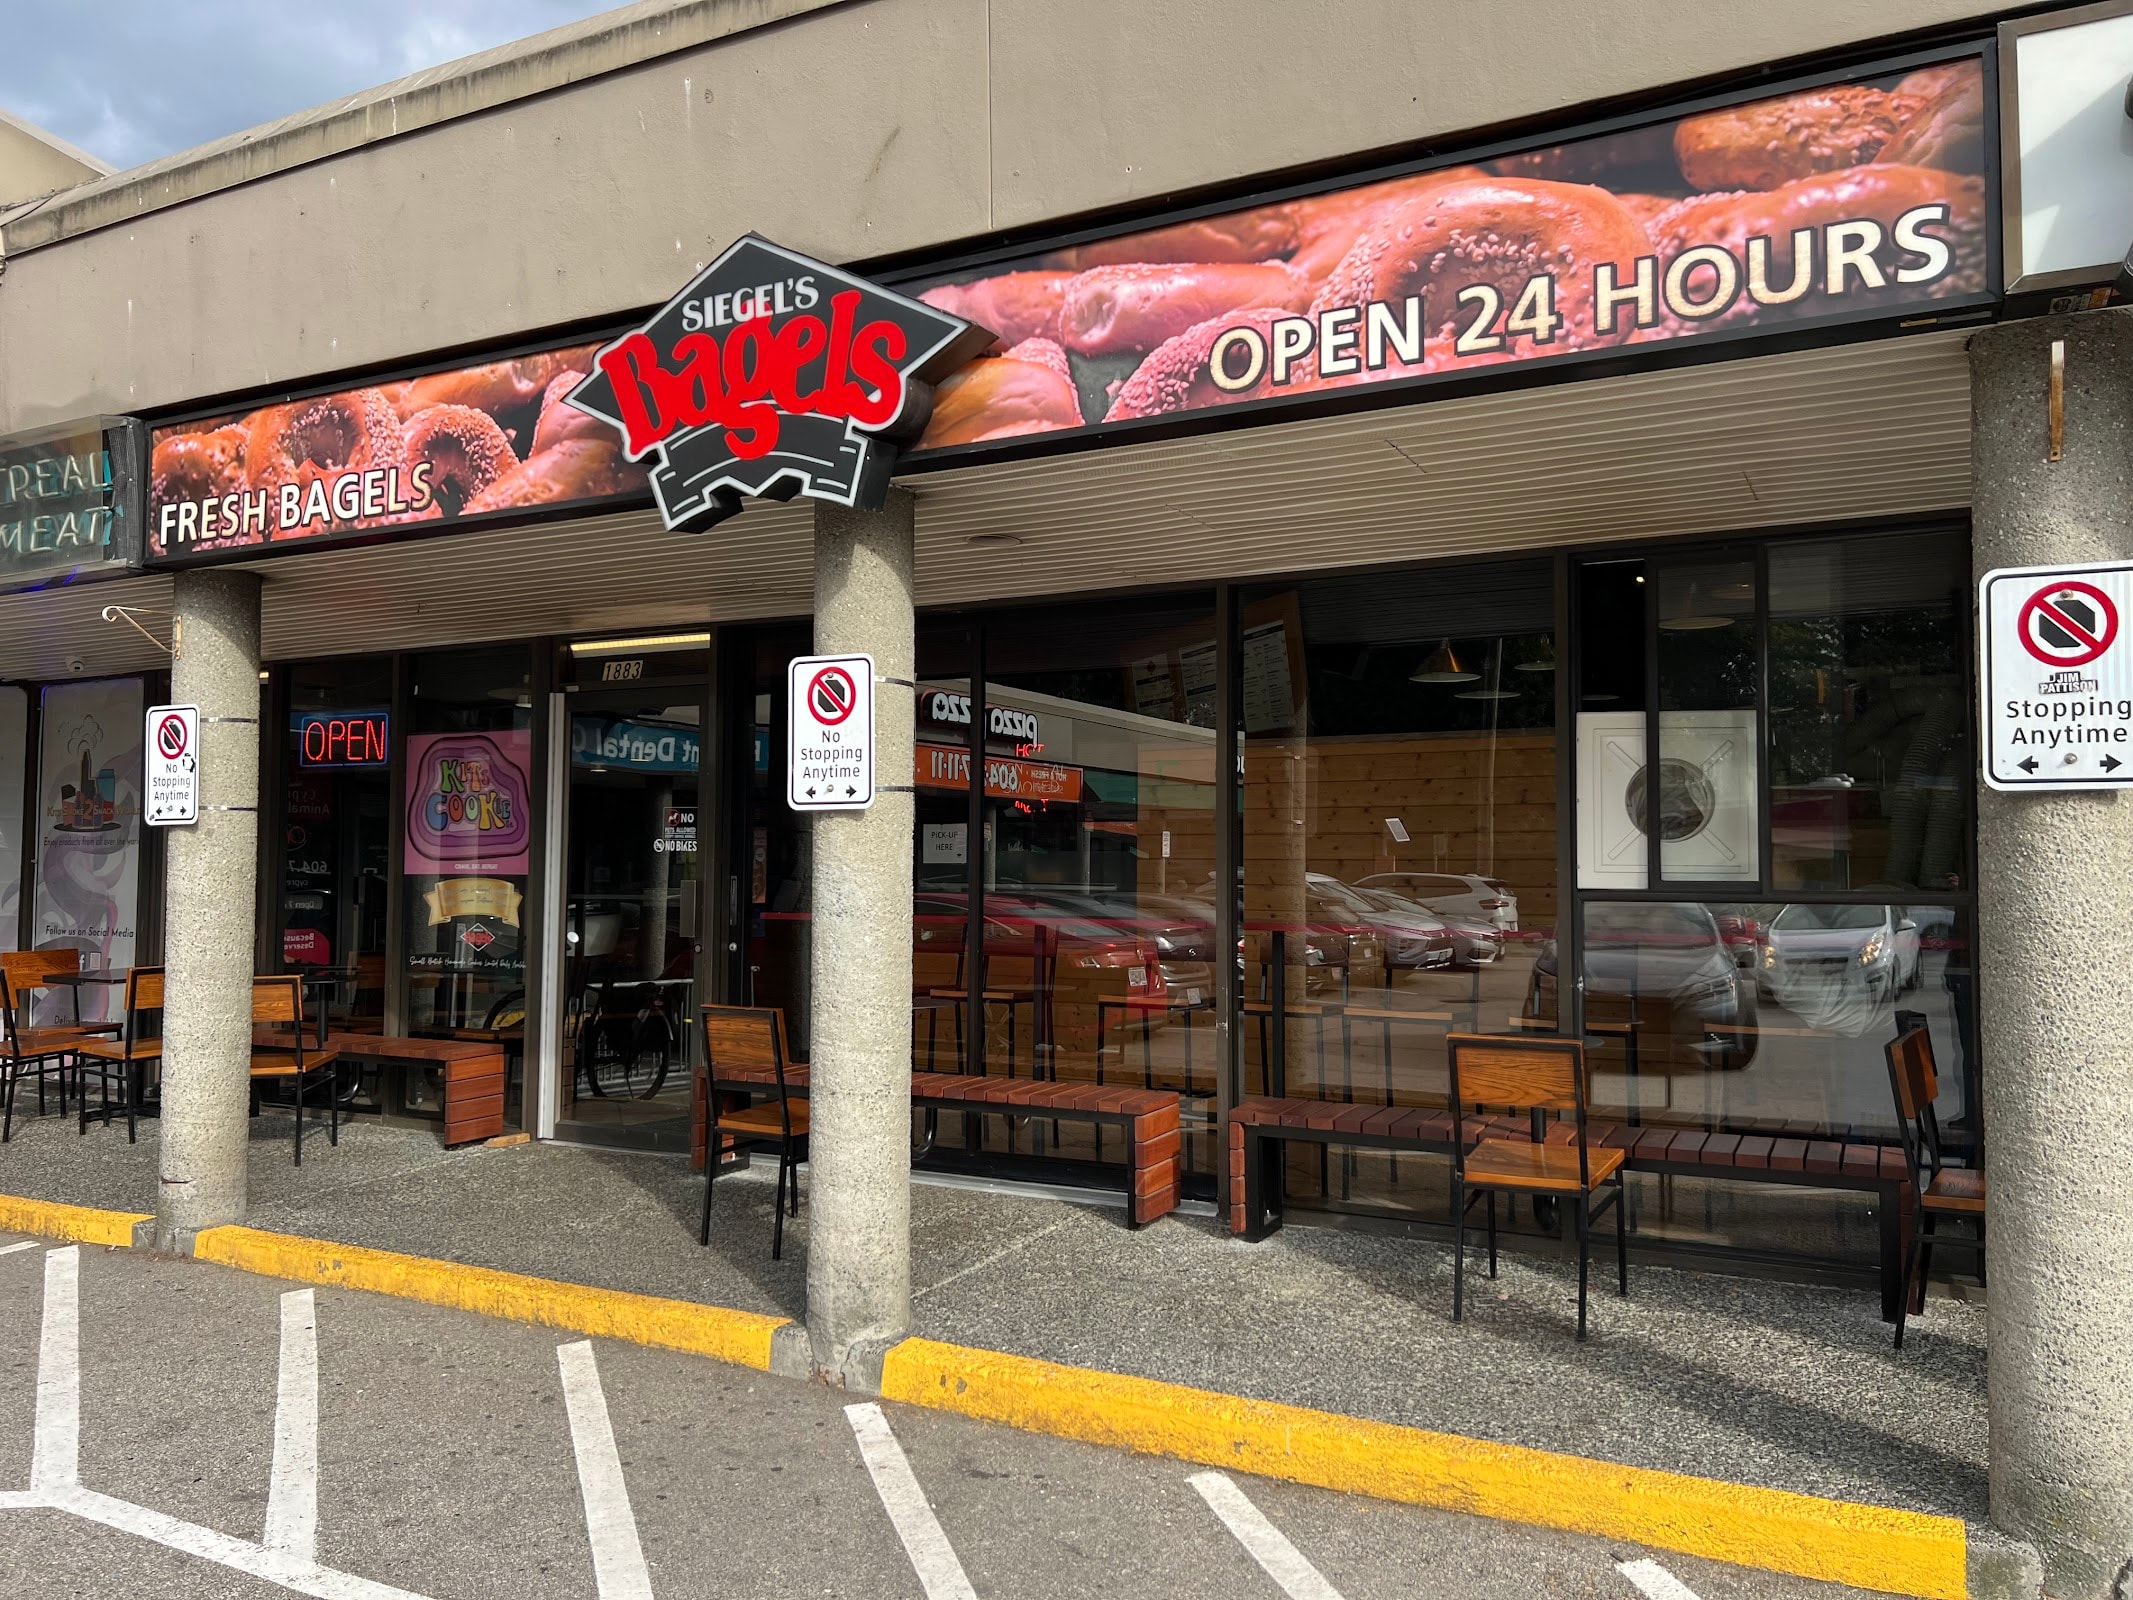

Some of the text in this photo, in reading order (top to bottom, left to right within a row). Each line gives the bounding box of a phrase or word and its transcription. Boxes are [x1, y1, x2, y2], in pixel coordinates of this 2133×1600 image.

[681, 276, 820, 332] SIEGEL'S
[1208, 204, 1952, 395] OPEN 24 HOURS
[599, 290, 907, 460] Bagels
[0, 451, 110, 502] REAL
[159, 462, 433, 546] FRESH BAGELS
[605, 661, 641, 680] 1883
[2056, 672, 2079, 683] JIM
[2040, 680, 2097, 694] PATTISON
[2006, 697, 2132, 721] Stopping
[305, 720, 385, 761] OPEN
[822, 730, 841, 743] No
[2011, 724, 2127, 749] Anytime
[801, 746, 862, 763] Stopping
[165, 763, 178, 773] No
[440, 759, 490, 793] KITS
[803, 765, 860, 781] Anytime
[153, 775, 191, 788] Stopping
[154, 790, 190, 803] Anytime
[426, 791, 511, 831] COOKIE
[680, 813, 695, 823] NO
[931, 831, 958, 839] PICK-UP
[665, 840, 698, 851] NO BIKES
[935, 843, 953, 851] HERE
[45, 925, 66, 935] Follow
[68, 927, 76, 936] us
[88, 926, 109, 937] Social
[111, 927, 134, 938] Media
